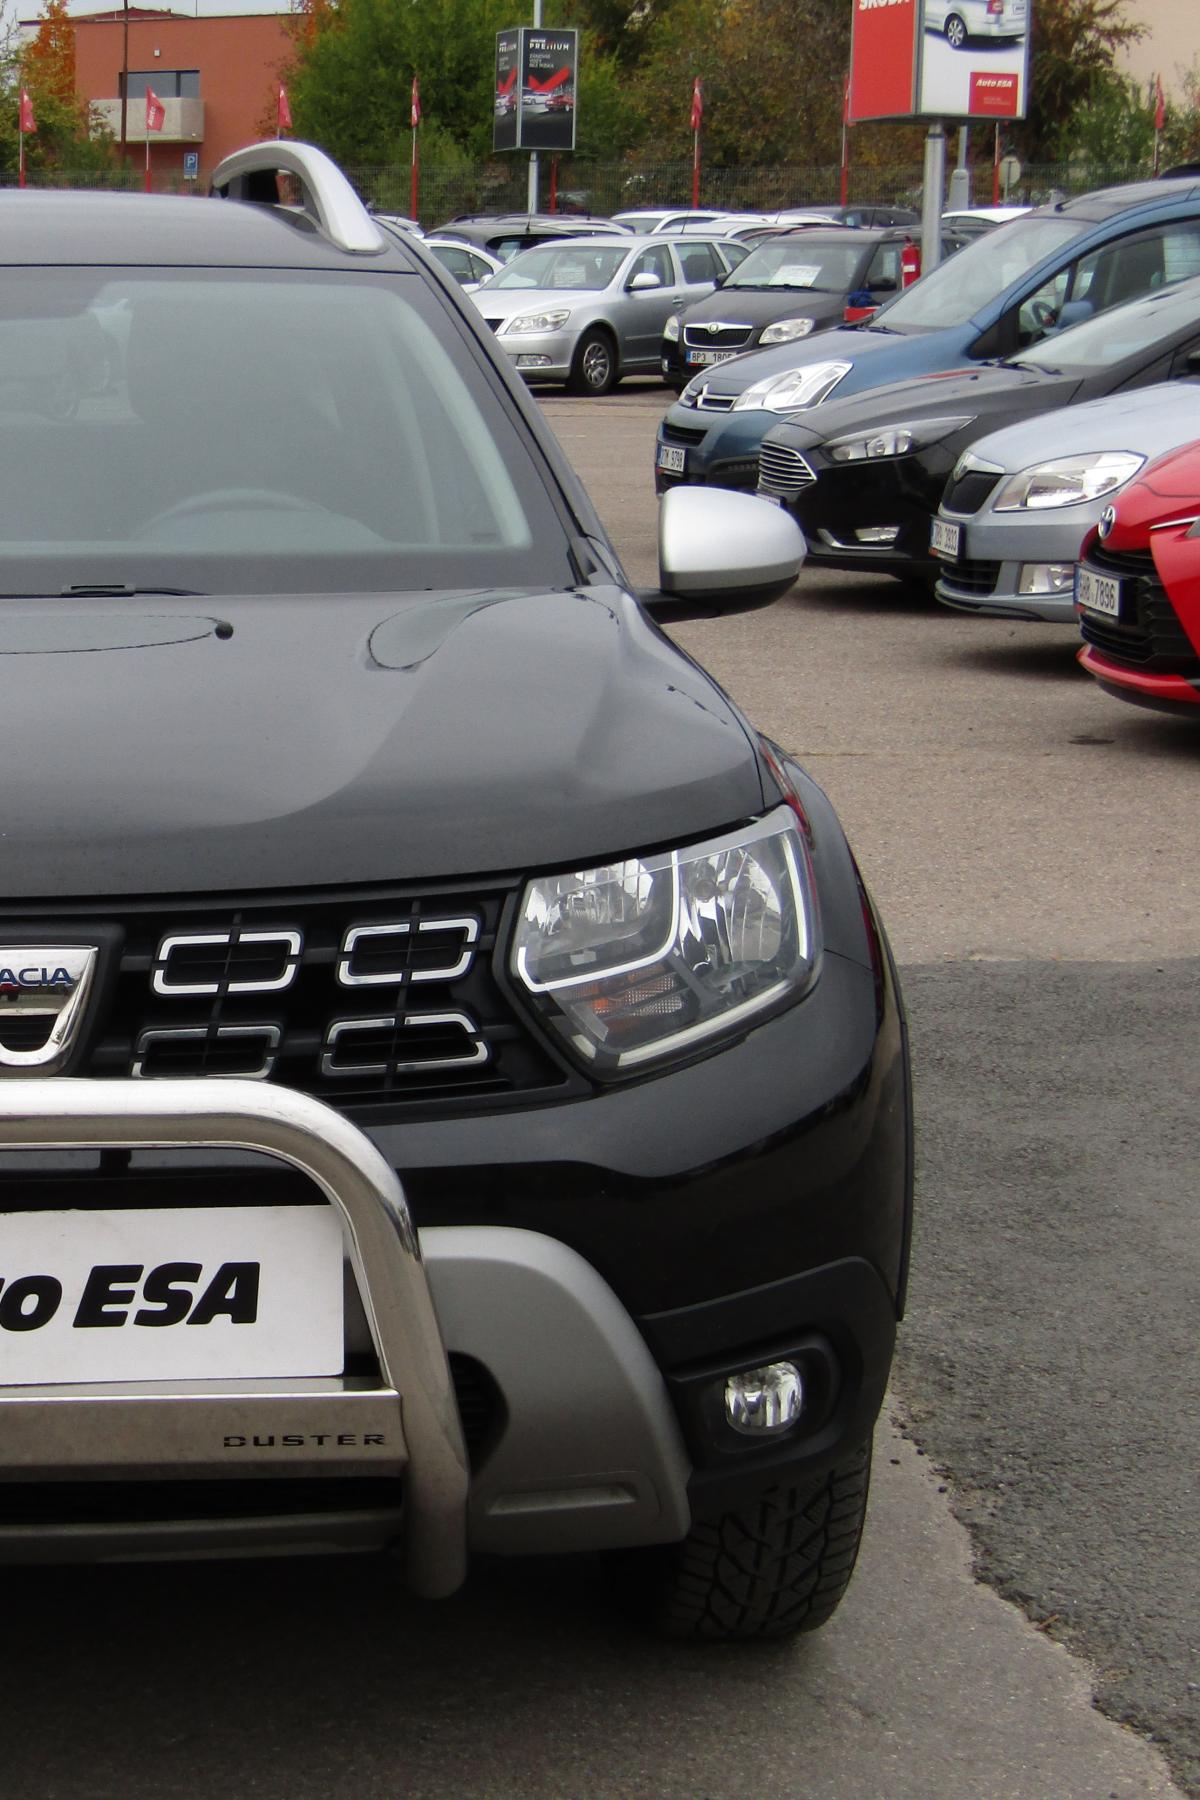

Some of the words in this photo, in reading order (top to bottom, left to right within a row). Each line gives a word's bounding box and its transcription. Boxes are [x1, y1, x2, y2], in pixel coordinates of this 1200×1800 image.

[1095, 578, 1115, 610] 7896
[72, 1261, 261, 1328] ESA
[223, 1434, 386, 1448] DUSTER
